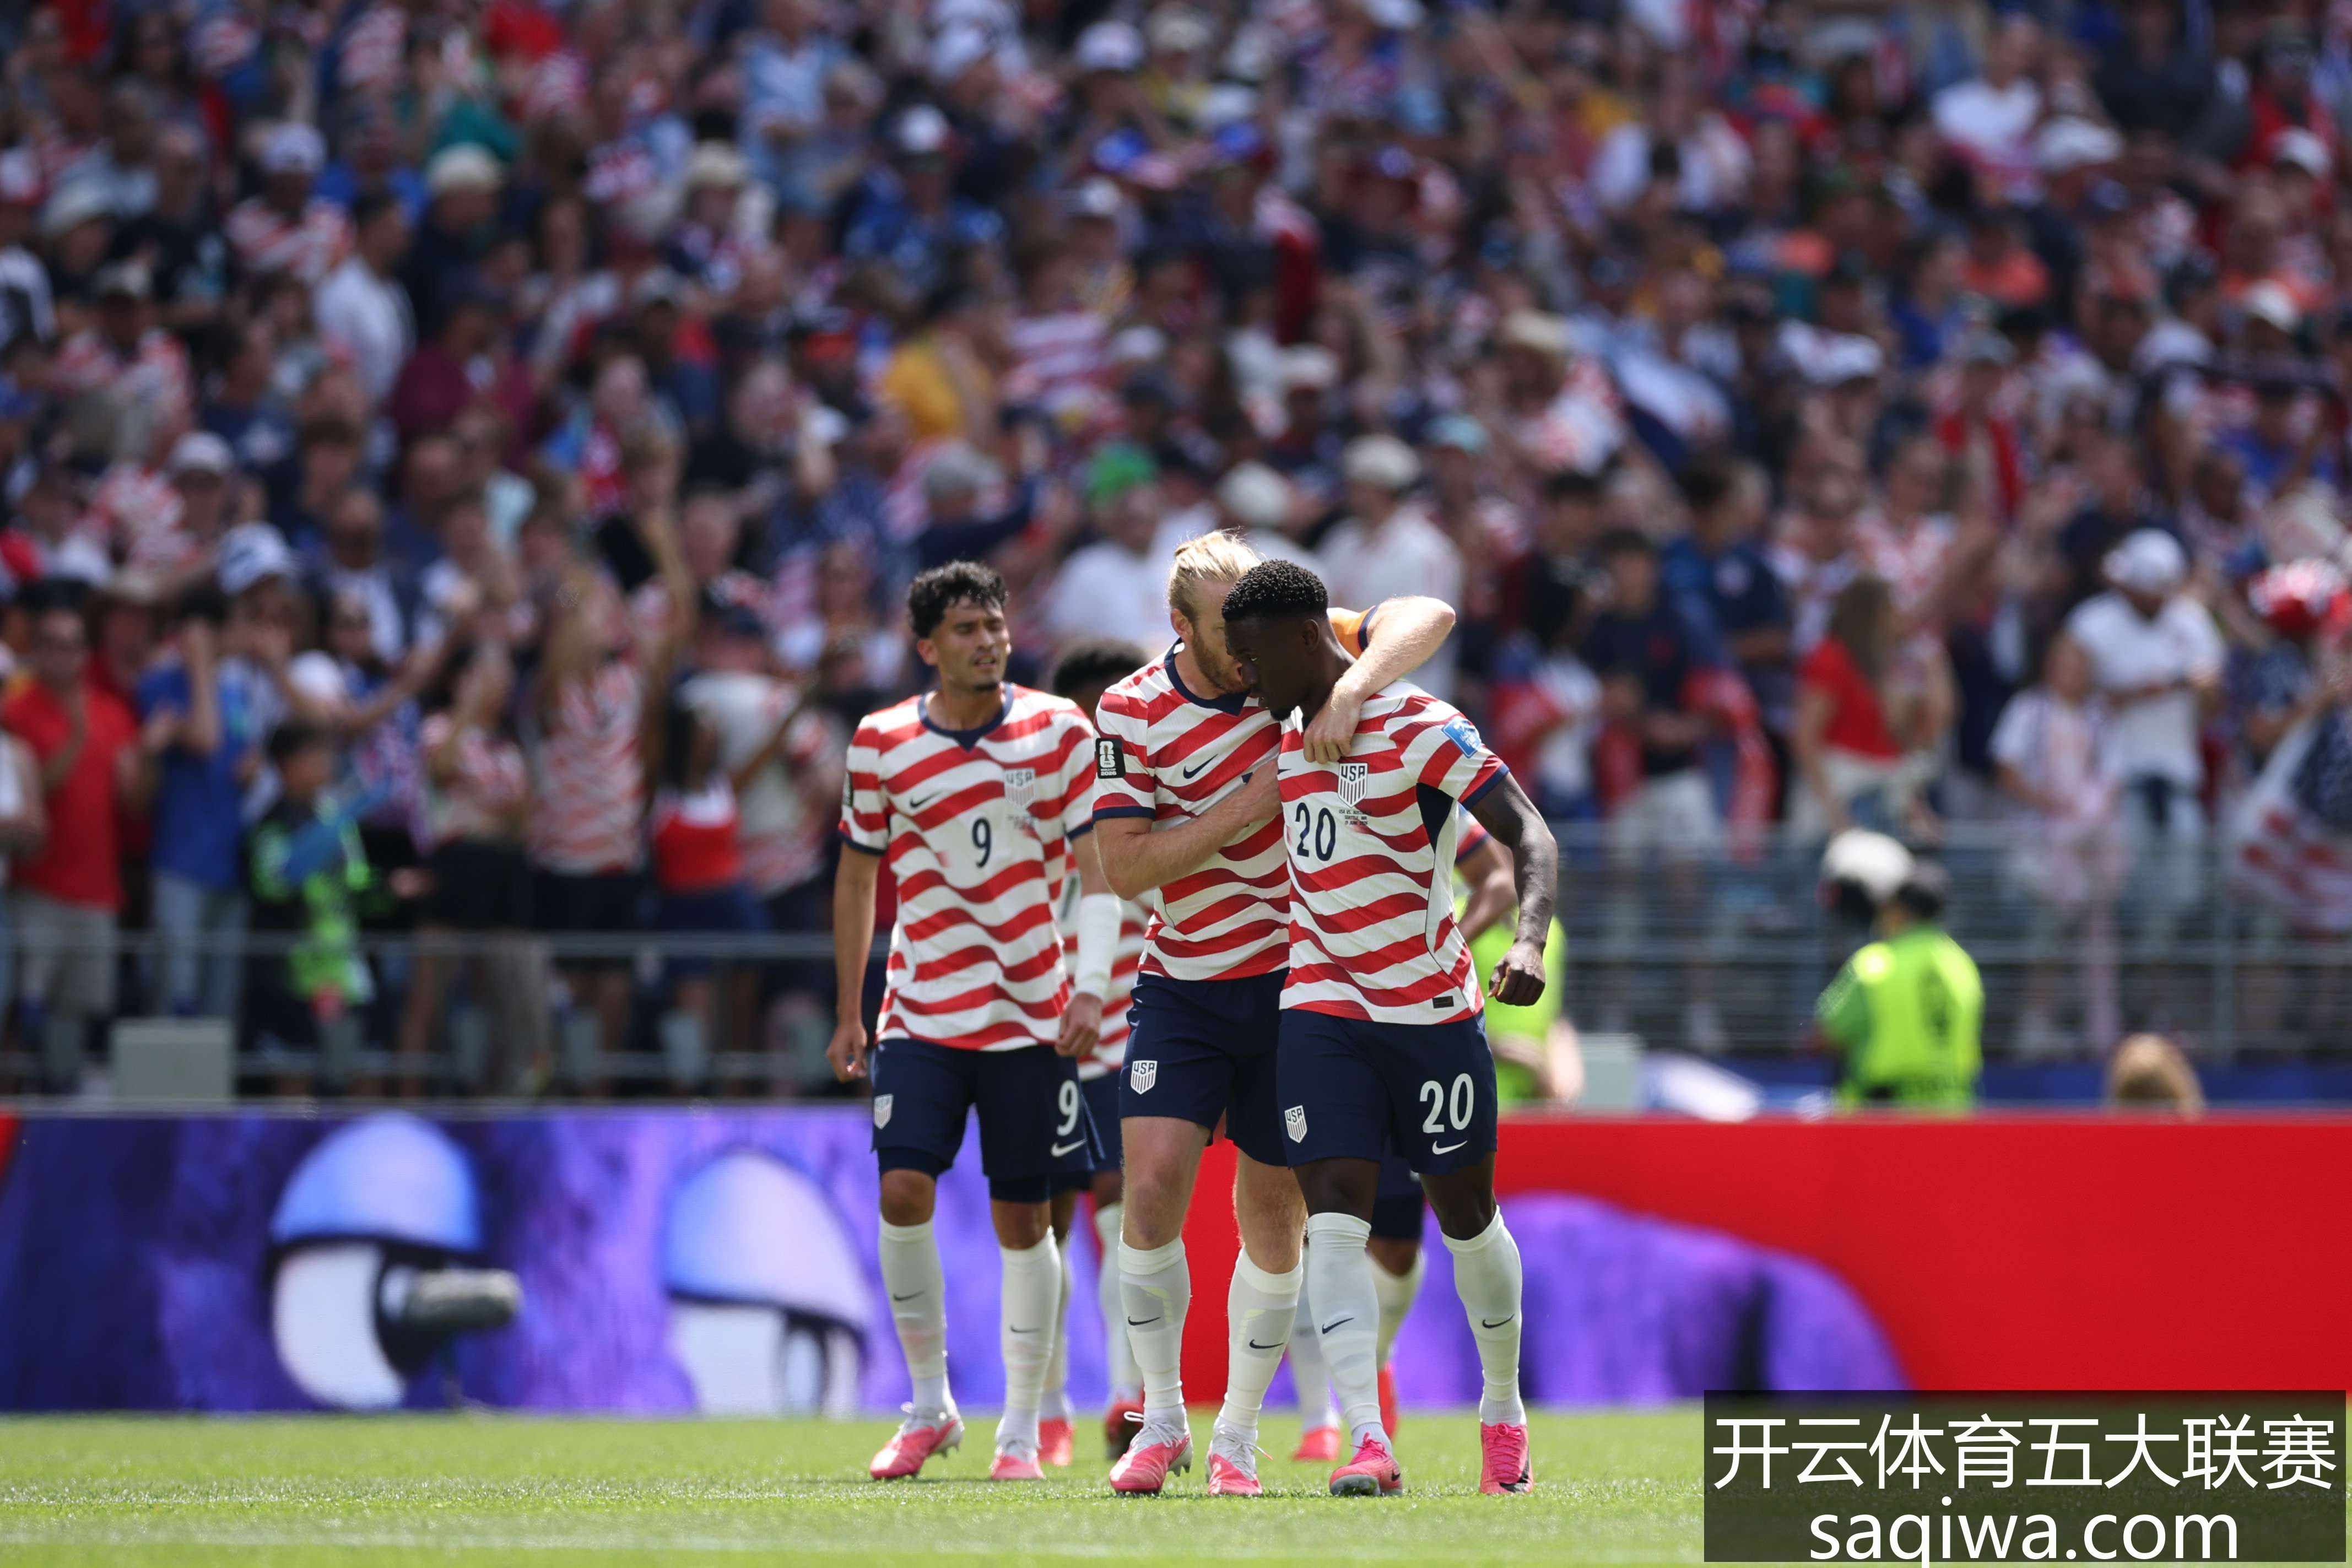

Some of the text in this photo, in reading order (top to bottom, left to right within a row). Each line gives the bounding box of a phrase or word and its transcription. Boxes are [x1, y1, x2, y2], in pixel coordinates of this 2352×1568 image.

[1006, 771, 1032, 787] USA
[1341, 766, 1365, 781] USA
[972, 818, 991, 868] 9
[1296, 803, 1335, 861] 20
[1134, 1062, 1155, 1075] USA
[1057, 1080, 1079, 1136] 9
[1286, 1107, 1302, 1123] USA
[1420, 1073, 1474, 1133] 20
